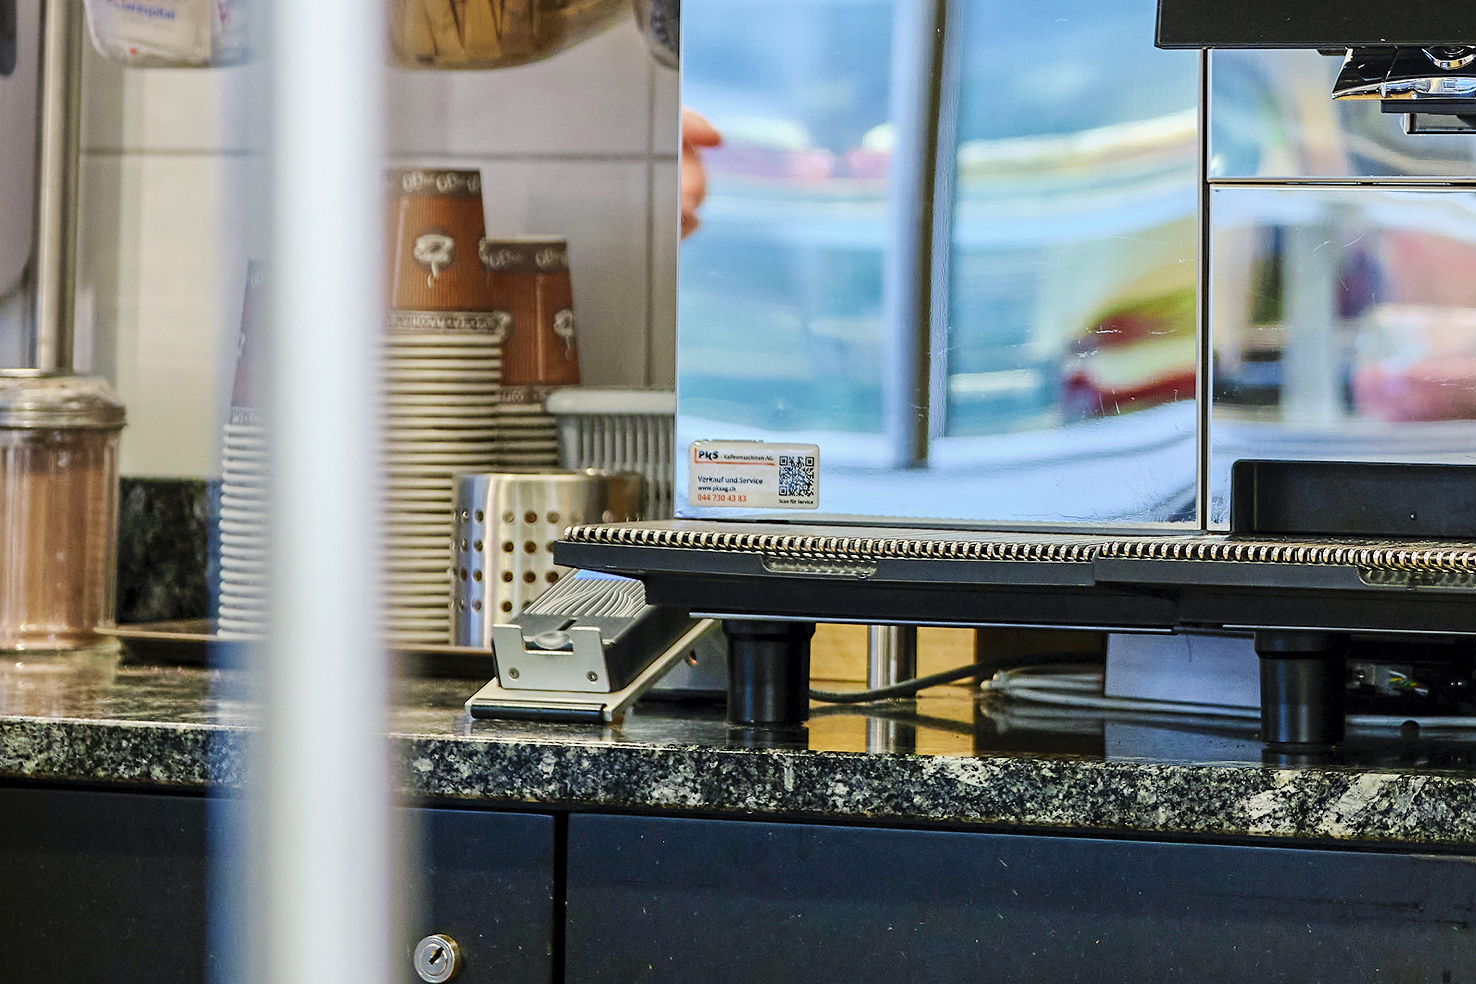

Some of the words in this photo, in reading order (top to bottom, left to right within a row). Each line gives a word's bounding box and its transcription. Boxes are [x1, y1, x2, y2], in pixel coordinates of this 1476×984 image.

[698, 475, 724, 484] Verkauf
[725, 476, 738, 485] und
[739, 476, 763, 485] Service
[697, 493, 711, 502] 044
[712, 494, 726, 502] 730
[727, 494, 736, 503] 43
[737, 494, 747, 503] 83
